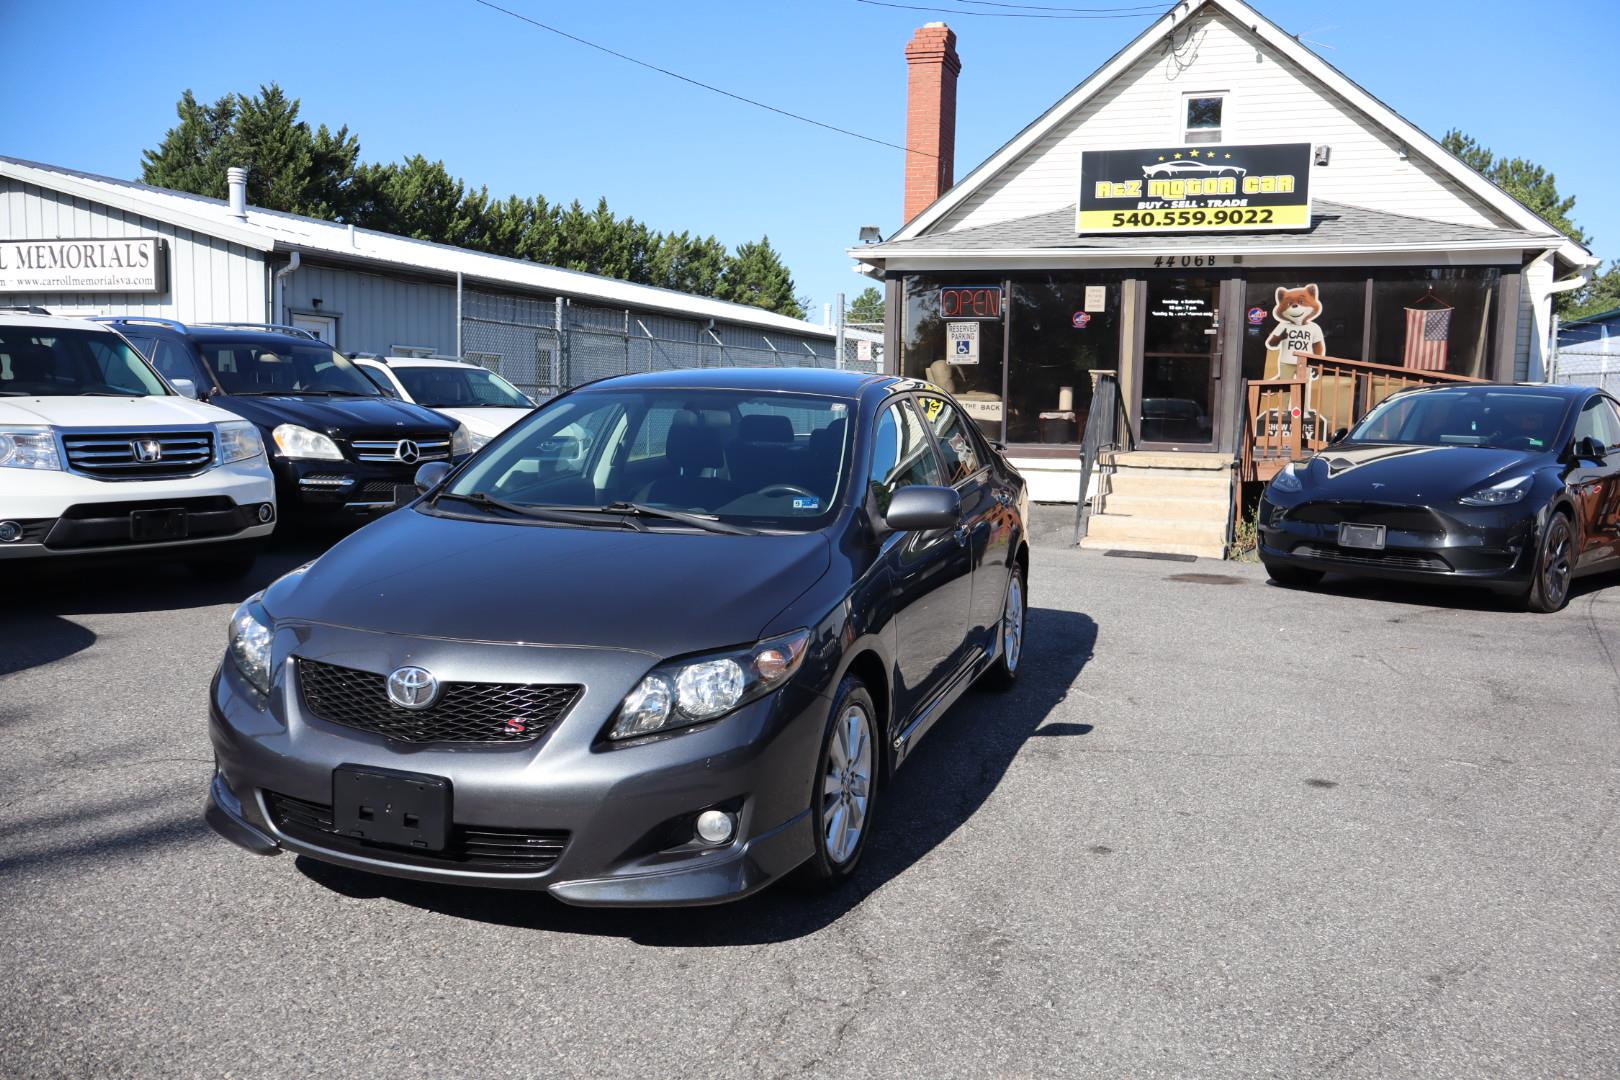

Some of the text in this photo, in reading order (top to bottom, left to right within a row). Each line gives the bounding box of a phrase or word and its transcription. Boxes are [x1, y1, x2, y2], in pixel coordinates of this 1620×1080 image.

[1147, 177, 1237, 200] MOTOR
[1137, 199, 1249, 210] BUY SELL TRADE
[1112, 209, 1273, 227] 540.559.9022
[15, 243, 149, 270] MEMORIALS
[17, 275, 153, 286] www.carrollmemorialsva.com
[943, 290, 999, 316] OPEN
[1289, 330, 1311, 340] CAR
[1288, 340, 1308, 351] FOX
